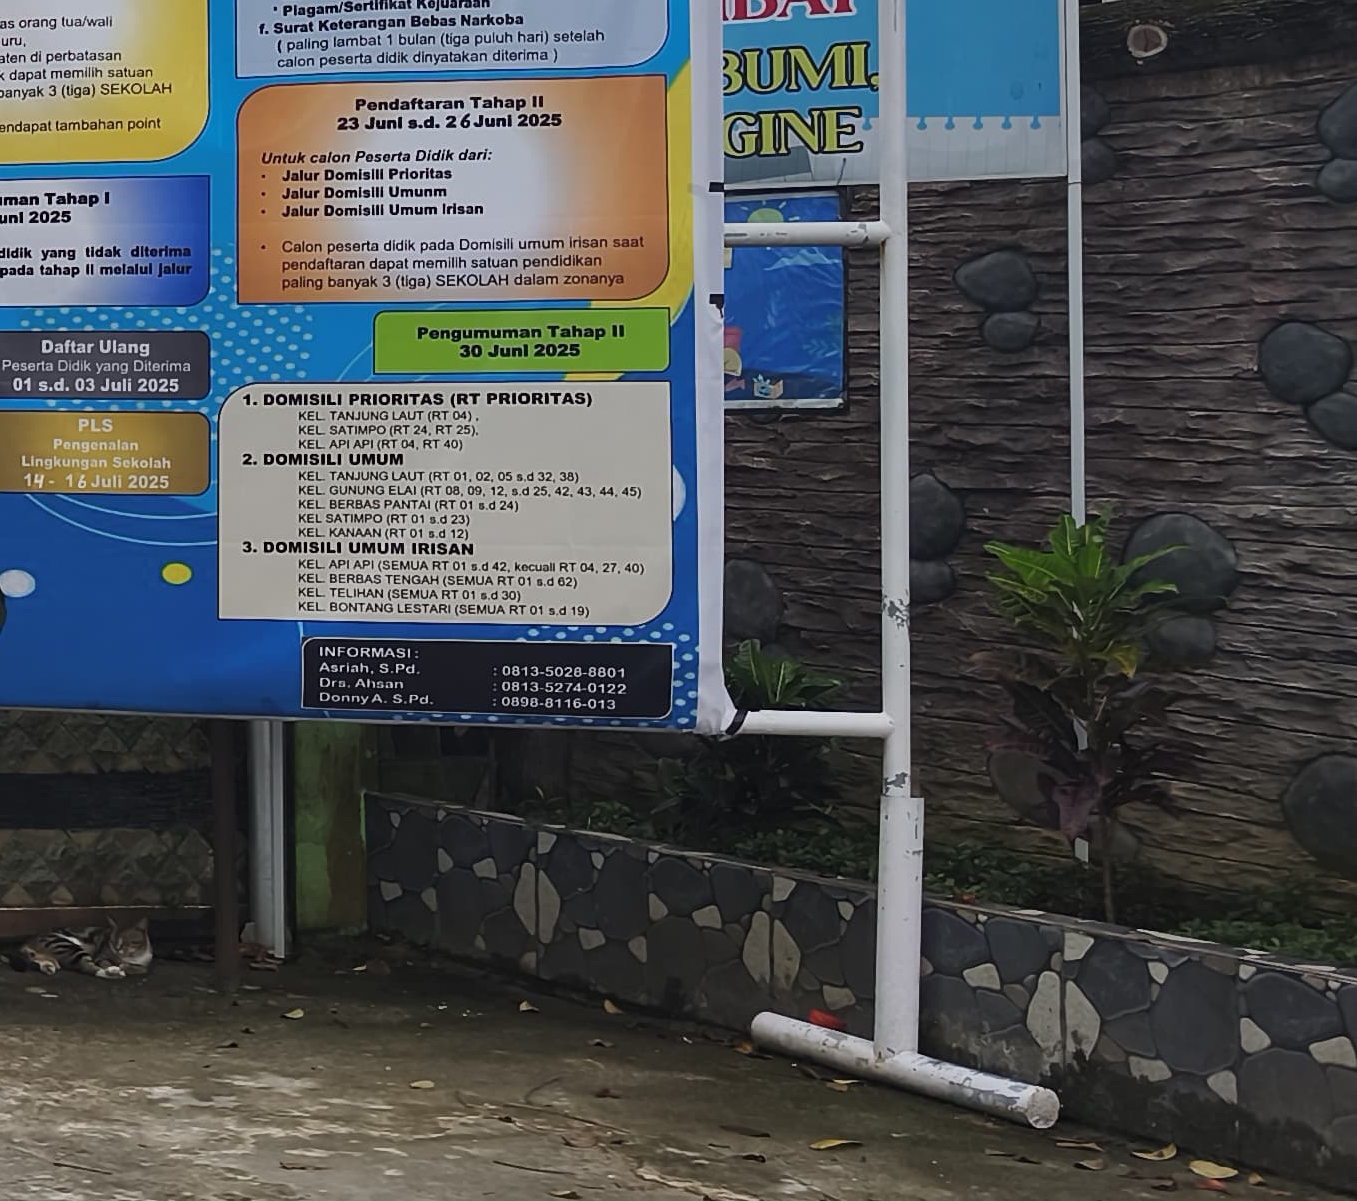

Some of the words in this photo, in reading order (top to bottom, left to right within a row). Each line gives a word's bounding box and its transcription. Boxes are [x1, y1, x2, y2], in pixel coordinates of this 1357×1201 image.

[259, 23, 268, 35] f.
[273, 21, 314, 34] Surat
[318, 16, 406, 32] Keterangan
[411, 14, 456, 27] Bebas
[461, 13, 524, 25] Narkoba
[356, 96, 465, 111] Pendaftaran
[470, 96, 526, 111] Tahap
[531, 95, 543, 108] II
[337, 117, 360, 131] 23
[365, 116, 402, 130] Juni
[407, 115, 440, 129] s.d.
[445, 113, 471, 129] 26
[473, 114, 512, 128] Juni
[518, 113, 562, 127] 2025
[44, 192, 99, 207] Tahap
[105, 191, 110, 204] I
[282, 204, 320, 217] Jalur
[324, 204, 384, 217] Domisili
[389, 203, 438, 216] Umum
[442, 203, 483, 216] Irisan
[29, 211, 71, 224] 2025
[417, 325, 542, 343] Pengumuman
[547, 325, 605, 342] Tahap
[612, 325, 624, 337] II
[41, 340, 94, 354] Daftar
[99, 340, 150, 356] Ulang
[459, 344, 483, 358] 30
[488, 343, 529, 357] Juni
[534, 343, 581, 358] 2025
[2, 360, 54, 372] Peserta
[58, 360, 90, 372] Didik
[96, 362, 128, 374] yang
[133, 360, 191, 372] Diterima
[13, 378, 32, 391] 01
[39, 378, 69, 391] s.d.
[75, 378, 95, 391] 03
[100, 378, 132, 391] Juli
[138, 378, 179, 392] 2025
[243, 394, 258, 406] 1.
[263, 393, 342, 406] DOMISILI
[349, 393, 445, 406] PRIORITAS
[450, 392, 480, 407] (RT
[486, 392, 593, 407] PRIORITAS)
[329, 411, 388, 421] TANJUNG
[392, 411, 424, 421] LAUT
[427, 411, 450, 423] (RT
[453, 411, 474, 423] 04)
[78, 419, 113, 431] PLS
[53, 439, 138, 452] Pengenalan
[21, 455, 107, 469] Lingkungan
[112, 457, 171, 469] Sekolah
[243, 454, 258, 466] 2.
[263, 453, 342, 466] DOMISILI
[348, 453, 404, 466] UMUM
[91, 475, 122, 488] Juli
[128, 476, 169, 488] 2025
[243, 542, 258, 554] 3.
[263, 542, 342, 555] DOMISILI
[348, 542, 405, 555] UMUM
[412, 543, 474, 556] IRISAN
[319, 647, 411, 658] INFORMASI
[319, 663, 374, 675] Asriah,
[379, 663, 420, 674] S.Pd.
[502, 665, 625, 678] 0813-5028-8801
[320, 678, 350, 688] Drs.
[354, 678, 404, 689] Ahsan
[502, 681, 626, 694] 0813-5274-0122
[319, 692, 368, 706] Donny
[372, 694, 387, 703] A.
[393, 694, 433, 705] S.Pd.
[502, 696, 615, 710] 0898-8116-013
